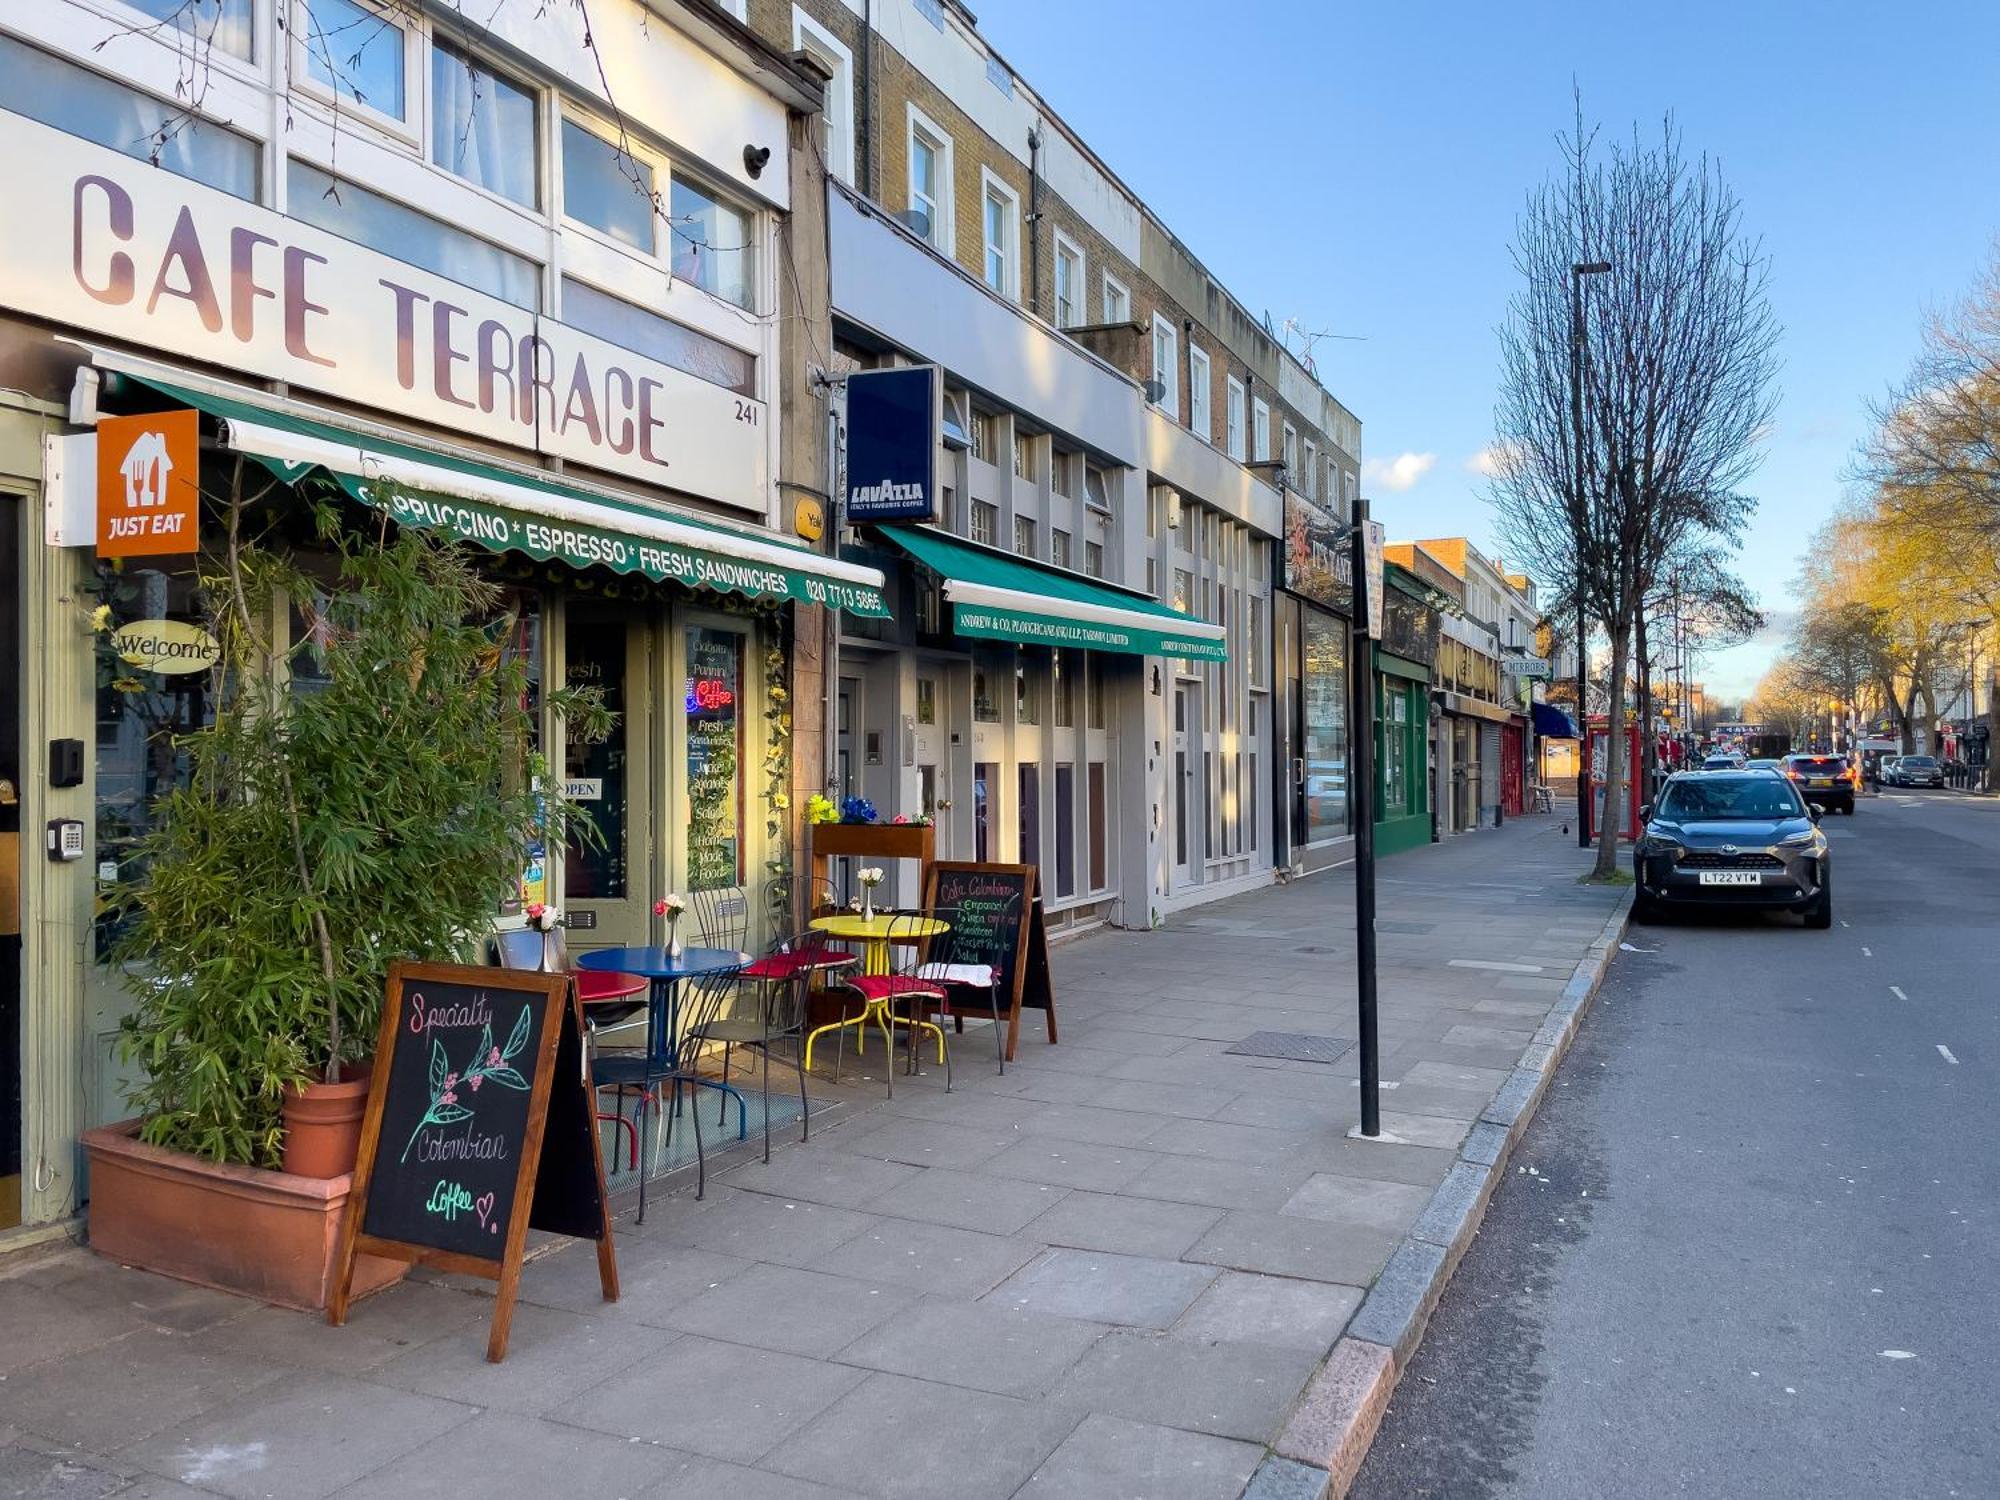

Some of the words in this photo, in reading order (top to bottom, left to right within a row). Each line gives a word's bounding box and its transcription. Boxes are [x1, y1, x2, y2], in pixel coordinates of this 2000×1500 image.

[73, 174, 336, 368] CAFE
[378, 278, 669, 467] TERRACE
[735, 400, 757, 426] 241
[851, 480, 923, 503] LAVAZZA
[109, 516, 149, 540] JUST
[152, 513, 186, 534] EAT
[358, 487, 509, 543] CPPUCCINO
[526, 523, 627, 564] ESPRESSO
[640, 547, 693, 583] FRESH
[696, 559, 788, 593] SANDWICHES
[806, 580, 826, 601] 020
[828, 584, 854, 607] 7713
[960, 614, 991, 630] ANDREW
[119, 634, 212, 660] Welcome
[1509, 662, 1545, 673] MIRRORS
[699, 720, 723, 732] Fresh
[1705, 873, 1732, 883] LT22
[411, 993, 493, 1047] Specialty
[427, 1180, 474, 1220] Coffee
